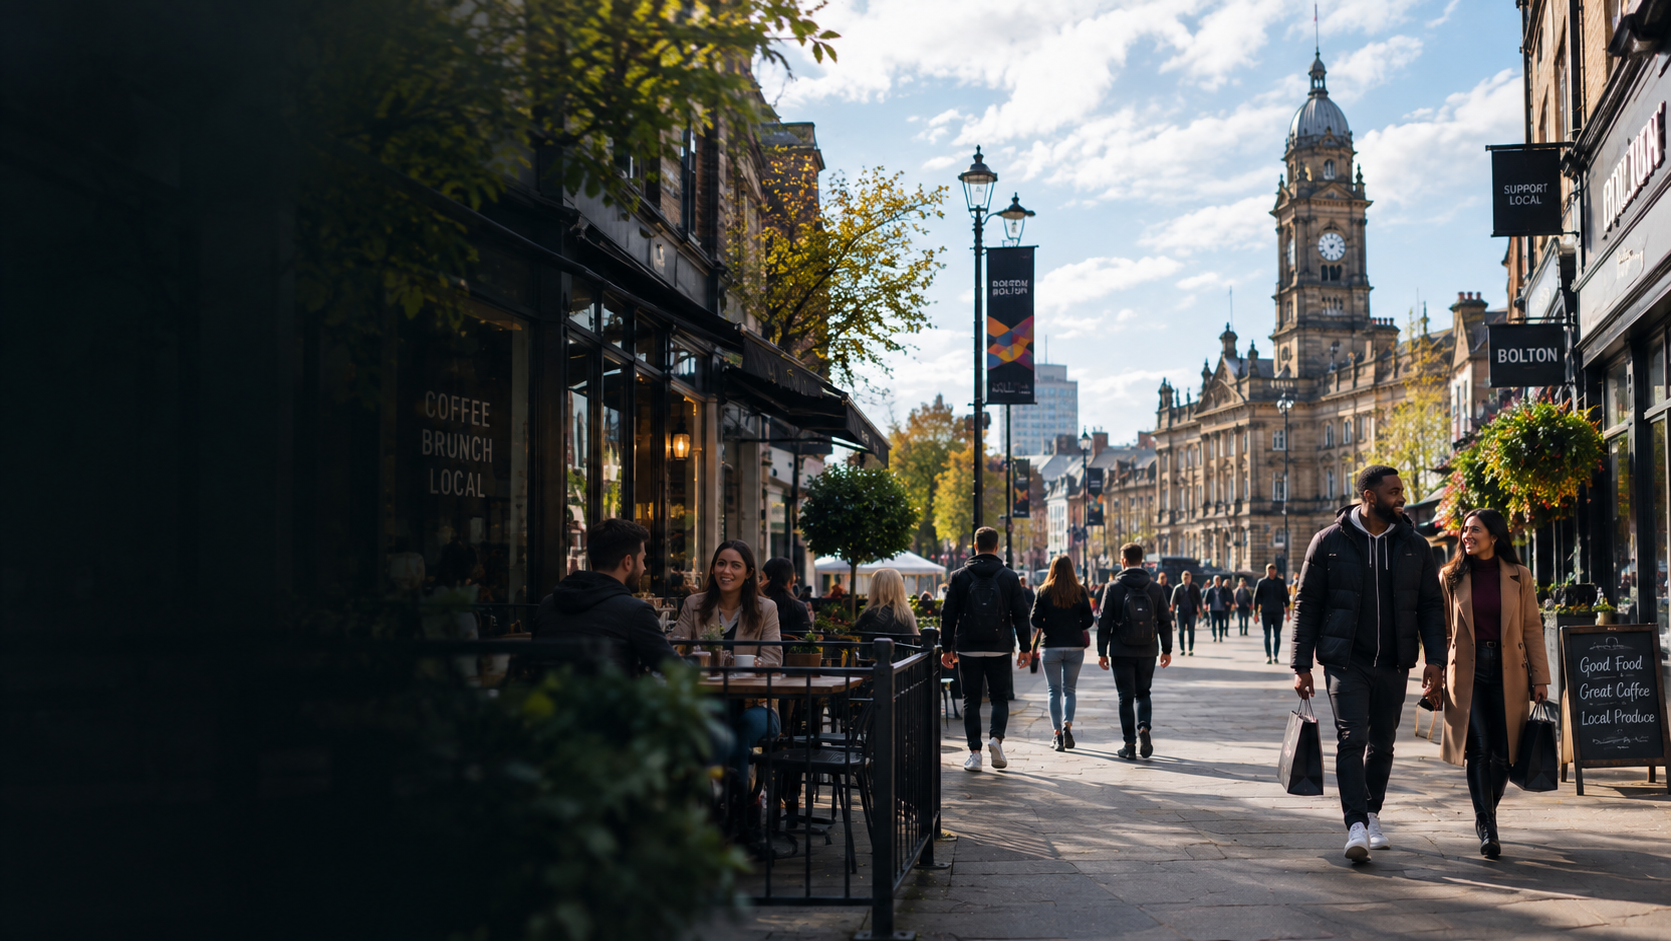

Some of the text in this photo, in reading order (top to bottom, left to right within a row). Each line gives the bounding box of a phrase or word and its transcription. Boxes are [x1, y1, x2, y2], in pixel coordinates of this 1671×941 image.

[1503, 183, 1548, 195] SUPPORT
[1509, 195, 1543, 206] LOCAL
[1497, 347, 1558, 364] BOLTON
[425, 390, 491, 428] COFFEE
[422, 428, 493, 463] BRUNCH
[430, 468, 486, 498] LOCAL
[1579, 654, 1643, 678] Good Food
[1579, 682, 1613, 700] Great
[1581, 708, 1655, 726] Local Produce
